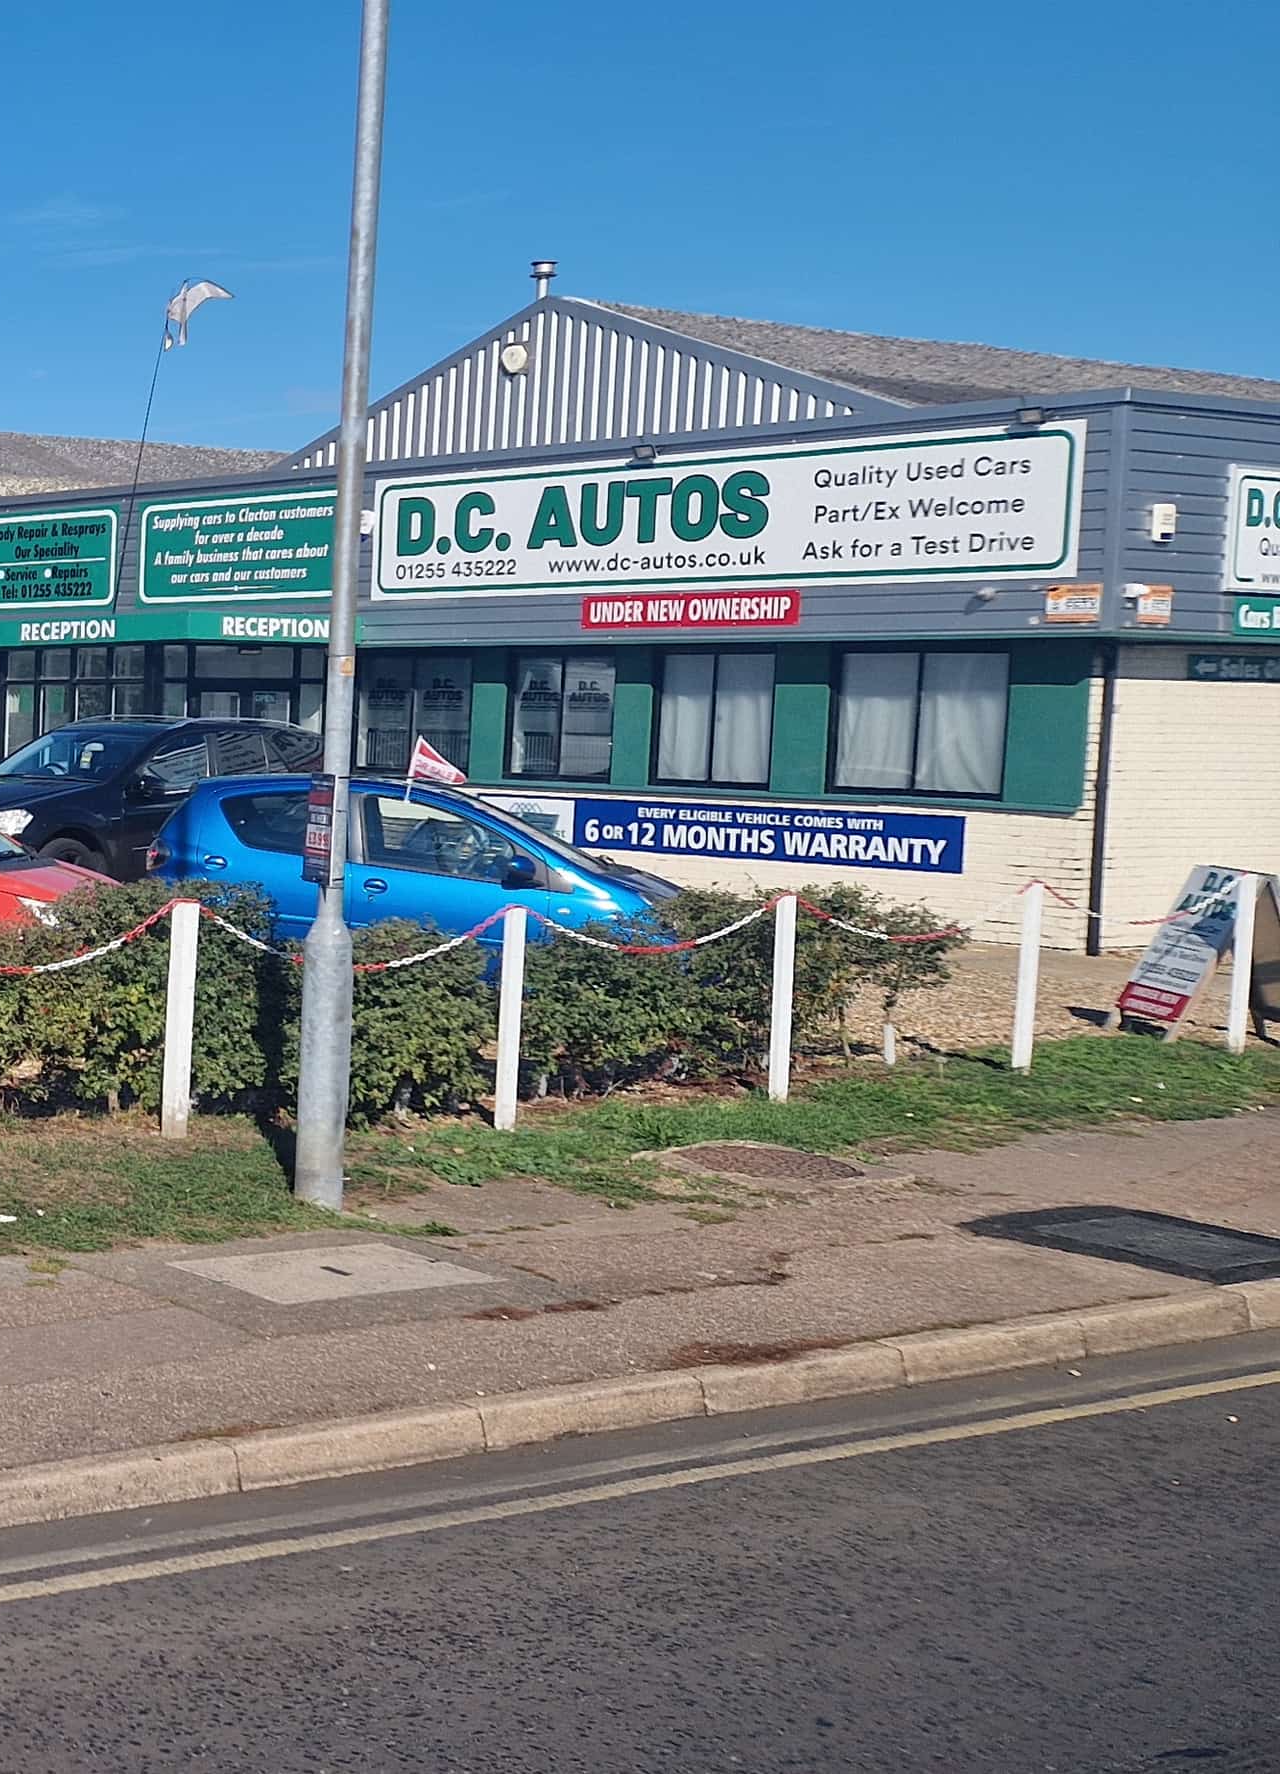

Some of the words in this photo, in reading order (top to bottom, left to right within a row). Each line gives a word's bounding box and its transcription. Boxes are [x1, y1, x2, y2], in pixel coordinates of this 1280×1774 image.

[814, 464, 897, 488] Quality
[906, 458, 965, 482] Used
[974, 456, 1032, 476] Cars
[152, 513, 200, 531] Supplying
[202, 514, 223, 526] cars
[225, 511, 236, 524] to
[238, 507, 277, 523] Clacton
[279, 505, 334, 519] customers
[396, 491, 512, 556] D.C.
[526, 470, 770, 549] AUTOS
[814, 501, 900, 524] Part/Ex
[909, 497, 1025, 517] Welcome
[17, 524, 48, 541] Repair
[51, 523, 59, 537] &
[61, 522, 106, 538] Resprays
[194, 532, 210, 545] for
[212, 532, 235, 543] over
[237, 532, 244, 542] a
[246, 525, 285, 542] decade
[14, 545, 32, 559] Our
[34, 541, 80, 558] Speciality
[154, 553, 162, 566] A
[164, 550, 194, 567] family
[196, 548, 239, 563] business
[241, 545, 263, 560] that
[265, 547, 294, 560] cares
[296, 542, 328, 558] about
[802, 540, 843, 560] Ask
[850, 539, 883, 558] for
[890, 542, 902, 556] a
[911, 535, 961, 556] Test
[968, 532, 1035, 553] Drive
[396, 563, 446, 580] 01255
[451, 558, 517, 578] 435222
[548, 546, 766, 575] www.dc-autos.co.uk
[5, 567, 38, 582] Service
[51, 563, 89, 580] Repairs
[171, 573, 188, 584] our
[190, 571, 210, 584] cars
[212, 567, 232, 582] and
[234, 570, 253, 581] our
[254, 567, 307, 580] customers
[2, 583, 18, 599] Tel:
[21, 583, 52, 598] 01255
[54, 581, 92, 597] 435222
[590, 605, 643, 624] UNDER
[646, 602, 685, 622] NEW
[688, 597, 791, 621] OWNERSHIP
[20, 619, 116, 641] RECEPTION
[222, 616, 329, 638] RECEPTION
[1219, 656, 1260, 678] Sales
[637, 807, 676, 819] EVERY
[678, 810, 732, 823] ELIGIBLE
[735, 813, 790, 826] VEHICLE
[793, 816, 843, 829] COMES
[846, 818, 884, 831] WITH
[584, 819, 600, 843] 6
[603, 825, 623, 840] OR
[627, 823, 655, 847] 12
[662, 825, 775, 855] MONTHS
[783, 831, 946, 866] WARRANTY
